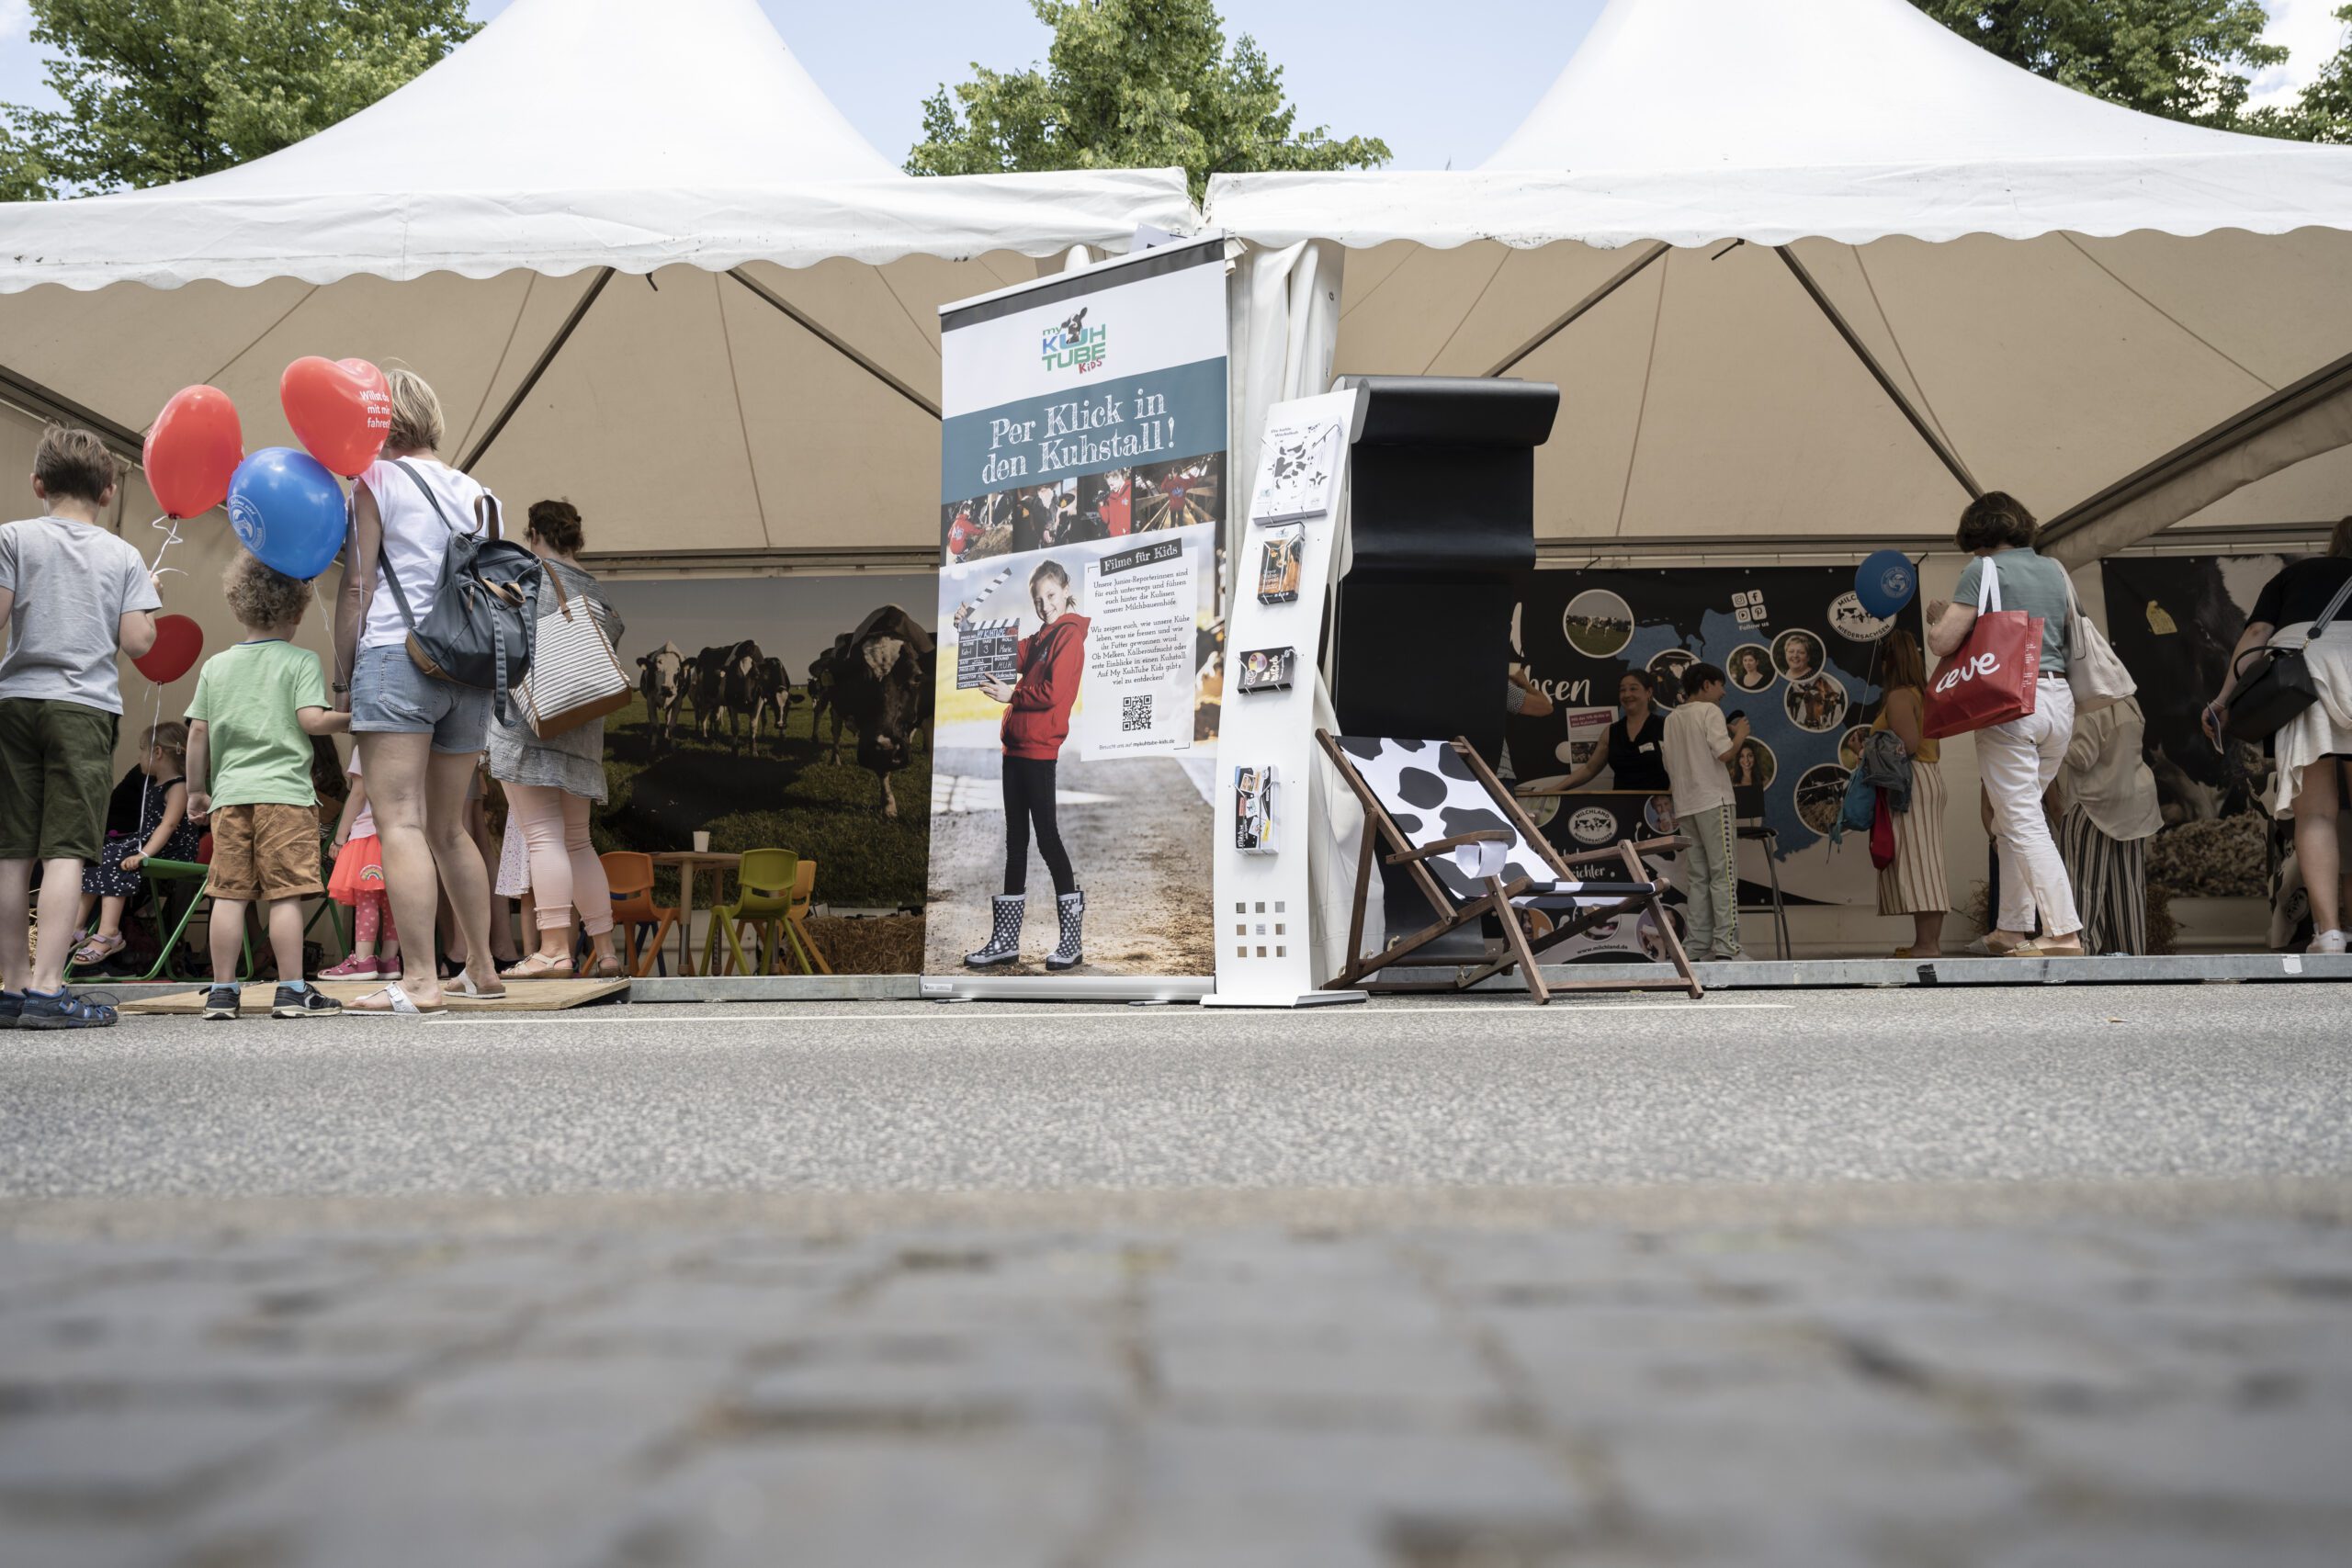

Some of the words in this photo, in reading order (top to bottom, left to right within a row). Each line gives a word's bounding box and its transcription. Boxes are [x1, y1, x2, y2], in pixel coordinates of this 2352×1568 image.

[1043, 327, 1062, 335] my
[1043, 323, 1106, 355] KUH
[1042, 342, 1106, 372] TUBE
[359, 389, 382, 401] Willst
[368, 403, 380, 414] mit
[989, 418, 1036, 450] Per
[1043, 394, 1124, 439] Klick
[1135, 389, 1168, 420] in
[982, 453, 1028, 485] den
[1037, 416, 1175, 474] Kuhstall!
[1104, 556, 1133, 572] Filme
[1136, 551, 1150, 564] für
[1153, 544, 1178, 559] Kids
[1093, 581, 1113, 589] Unsere
[1176, 569, 1189, 577] sind
[1121, 585, 1150, 593] unterwegs
[1166, 580, 1186, 588] führen
[1105, 596, 1119, 604] euch
[1121, 594, 1137, 603] hinter
[1150, 590, 1175, 599] Kulissen
[1174, 615, 1190, 623] Kühe
[1837, 625, 1891, 639] NIEDERSACHSEN
[983, 645, 989, 654] 3
[1129, 638, 1160, 649] gewonnen
[1102, 651, 1125, 660] Melken,
[1127, 645, 1172, 656] Kälberaufzucht
[1106, 659, 1132, 668] Einblicke
[1110, 670, 1120, 678] My
[1123, 665, 1148, 675] KuhTube
[1134, 673, 1164, 682] entdecken!
[1576, 809, 1610, 819] MILCHLAND
[1574, 832, 1613, 842] NIEDERSACHSEN
[1573, 863, 1606, 879] ichter
[1577, 943, 1628, 954] www.milchland.de
